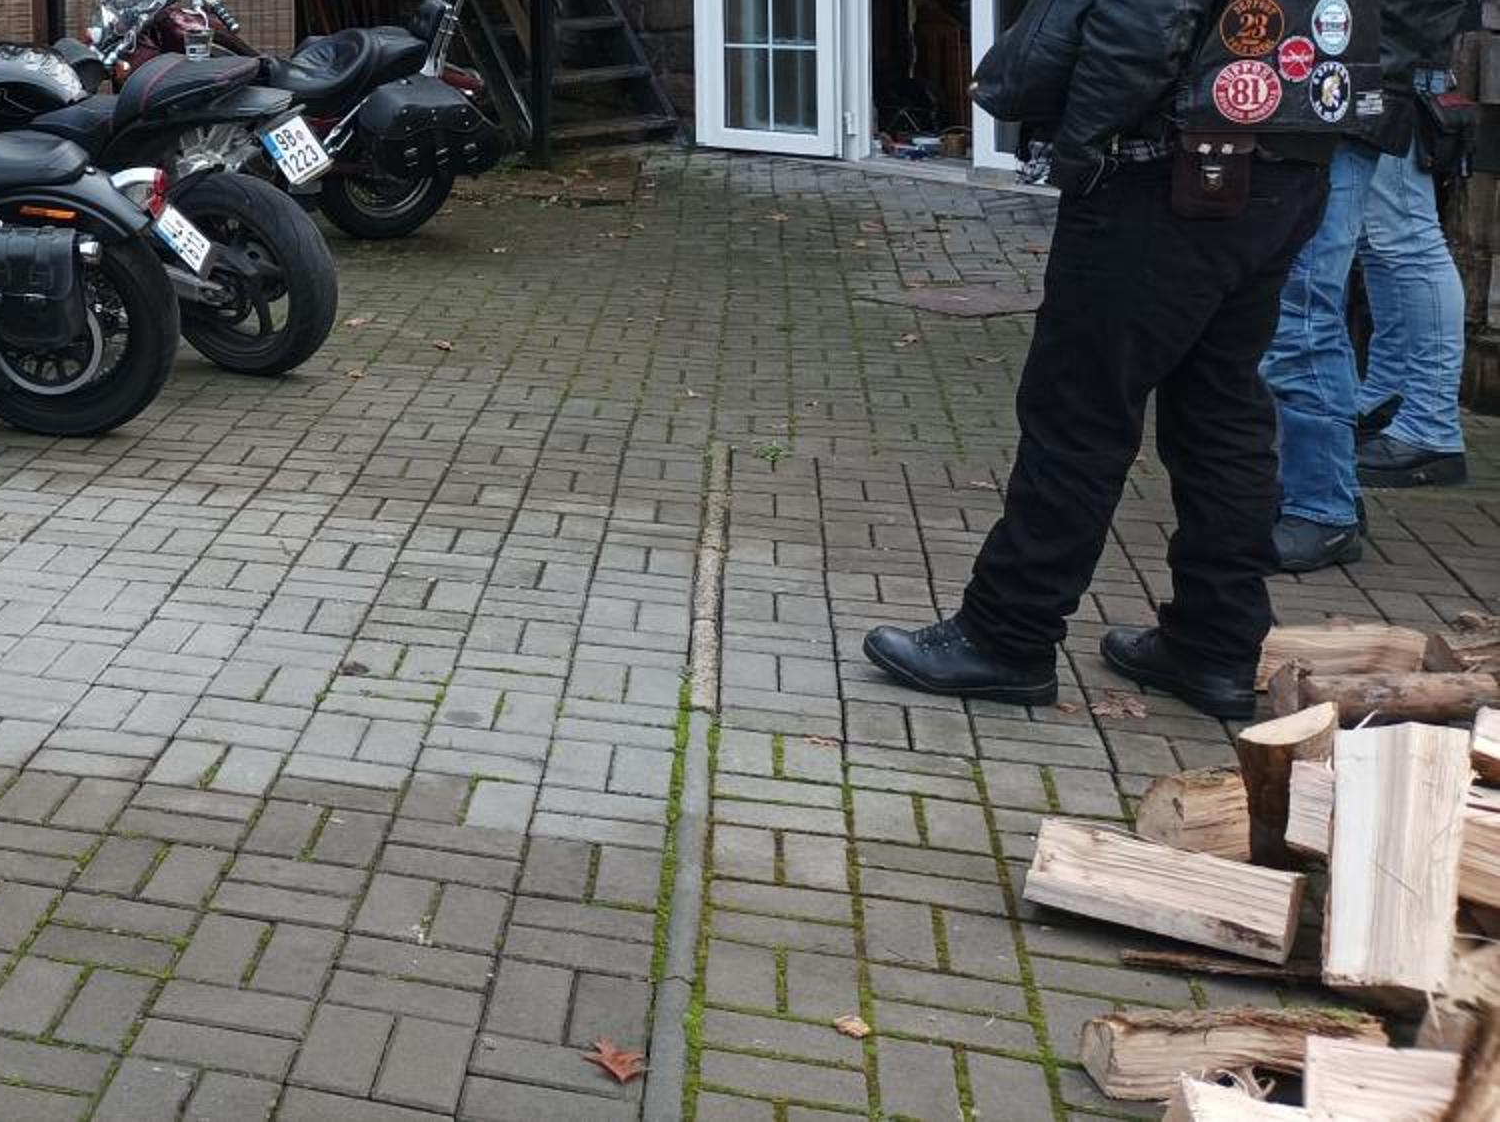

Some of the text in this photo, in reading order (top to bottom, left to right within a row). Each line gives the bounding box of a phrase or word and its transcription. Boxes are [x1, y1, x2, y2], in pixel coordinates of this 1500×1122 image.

[1217, 62, 1278, 85] SUPPORT
[1231, 77, 1261, 106] 81
[275, 129, 297, 151] 9B
[282, 144, 319, 177] 1223
